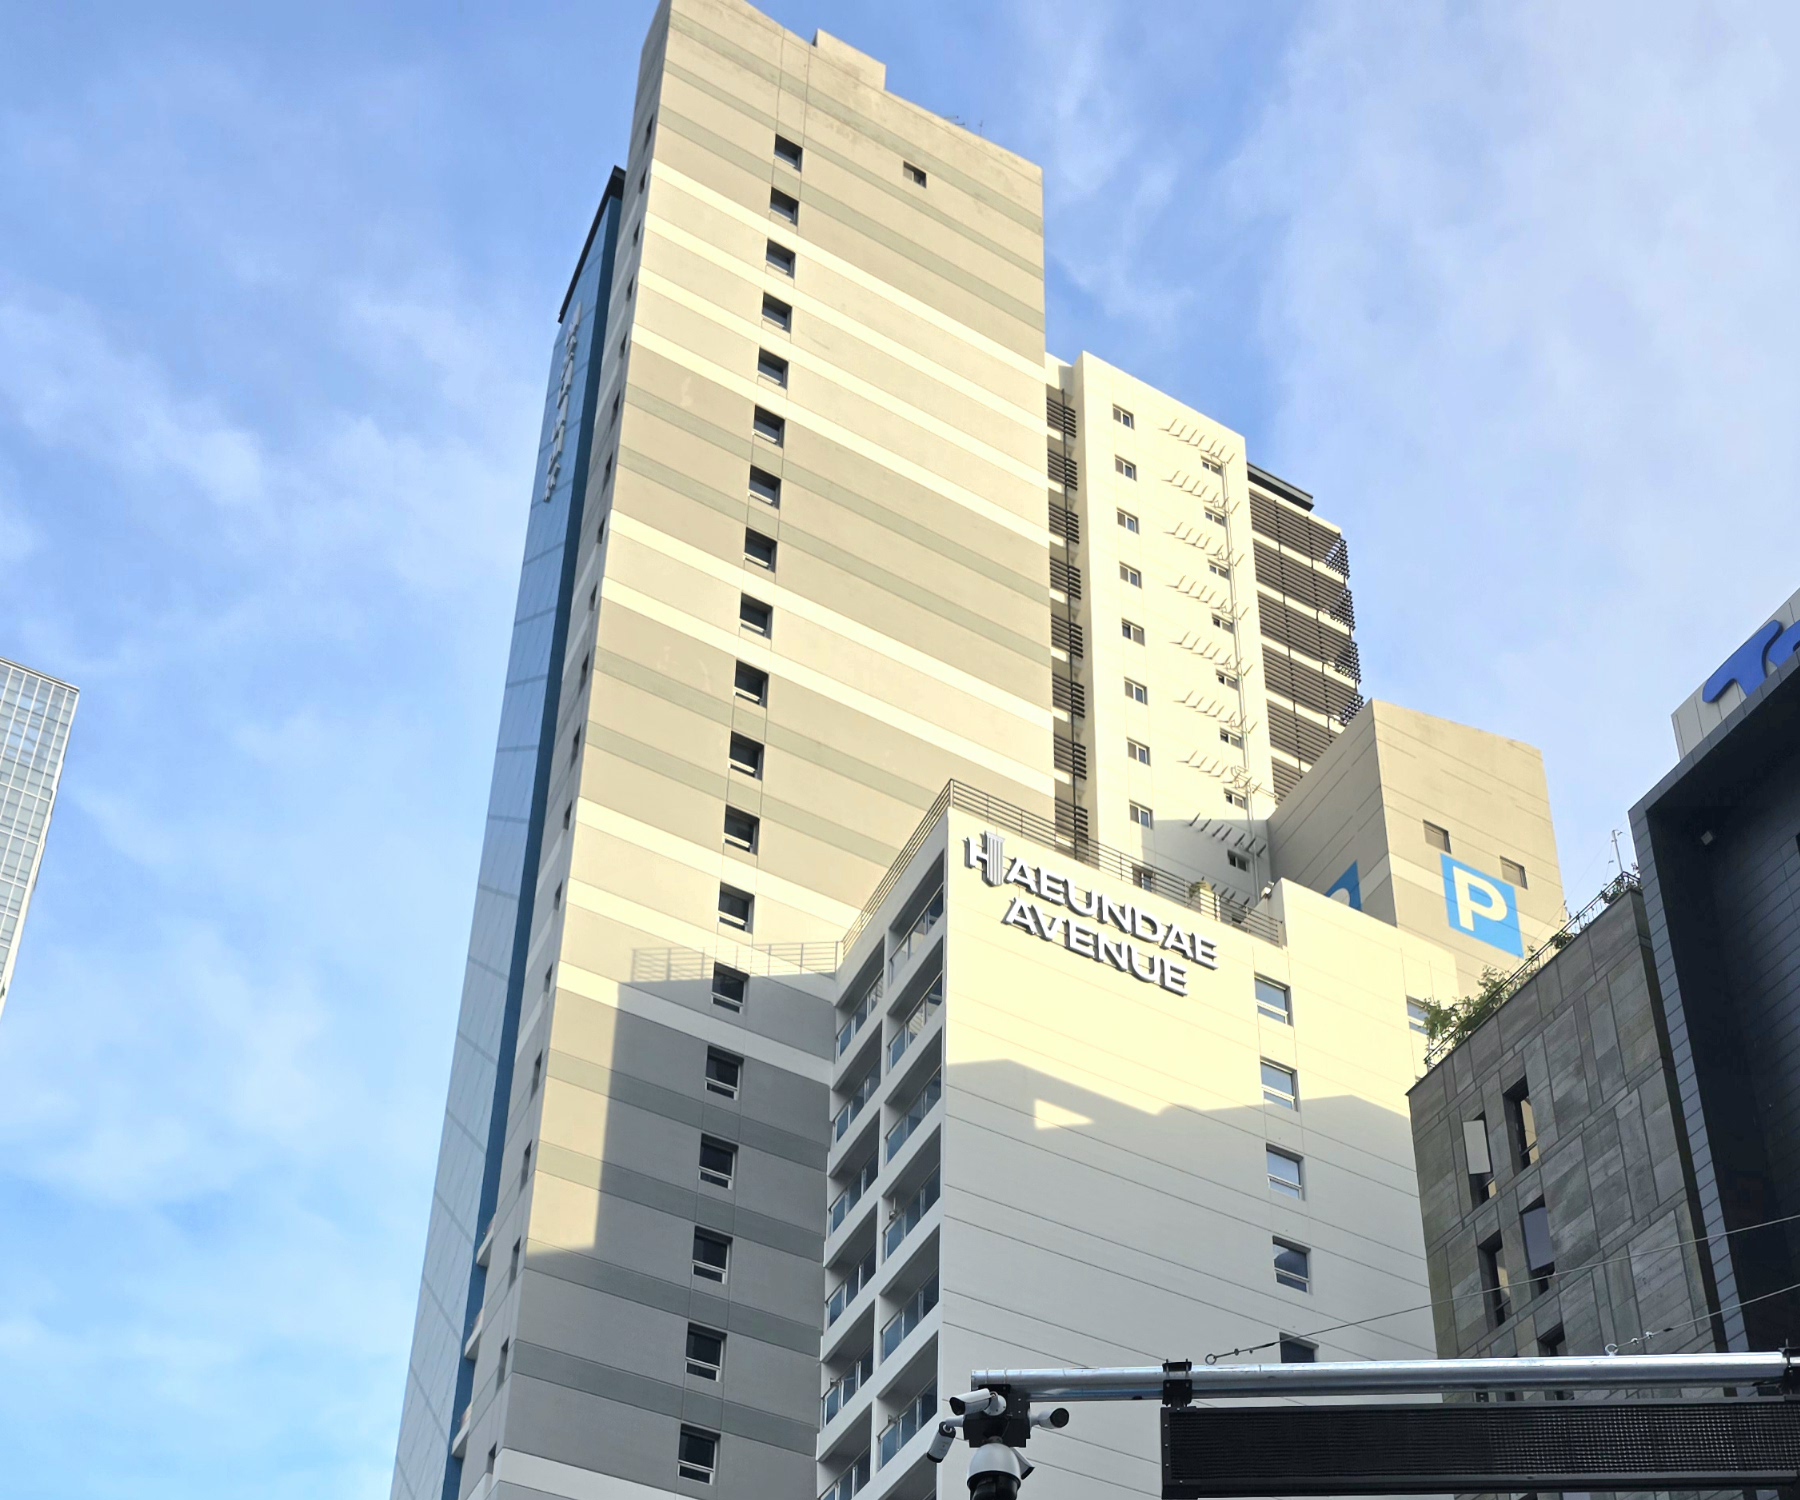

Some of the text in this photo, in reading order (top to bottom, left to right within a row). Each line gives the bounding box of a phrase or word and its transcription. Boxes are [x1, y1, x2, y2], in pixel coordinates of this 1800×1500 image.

[963, 831, 1218, 970] HAEUNDAE
[1002, 898, 1187, 996] AVENUE
[1453, 865, 1508, 931] P
